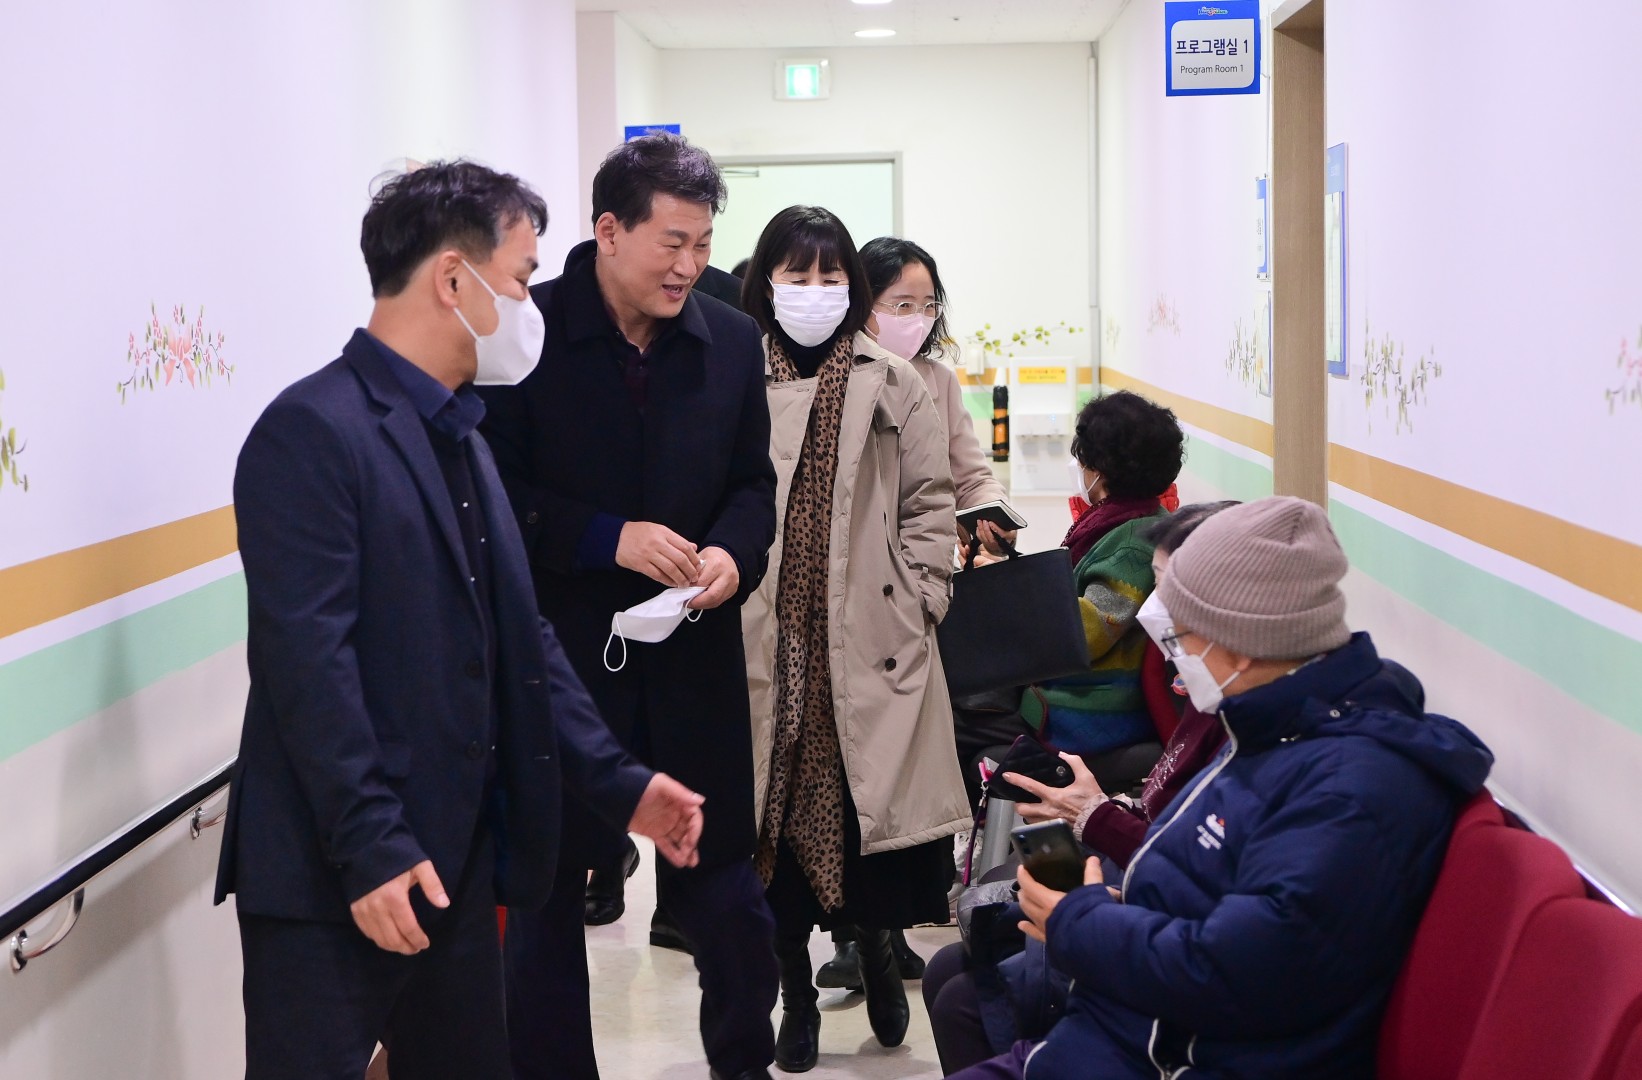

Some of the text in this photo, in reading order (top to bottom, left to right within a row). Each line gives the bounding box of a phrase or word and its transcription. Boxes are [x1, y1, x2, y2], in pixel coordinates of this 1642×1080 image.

[1175, 38, 1248, 56] 프로그램실 1
[1180, 64, 1244, 76] Program Room 1
